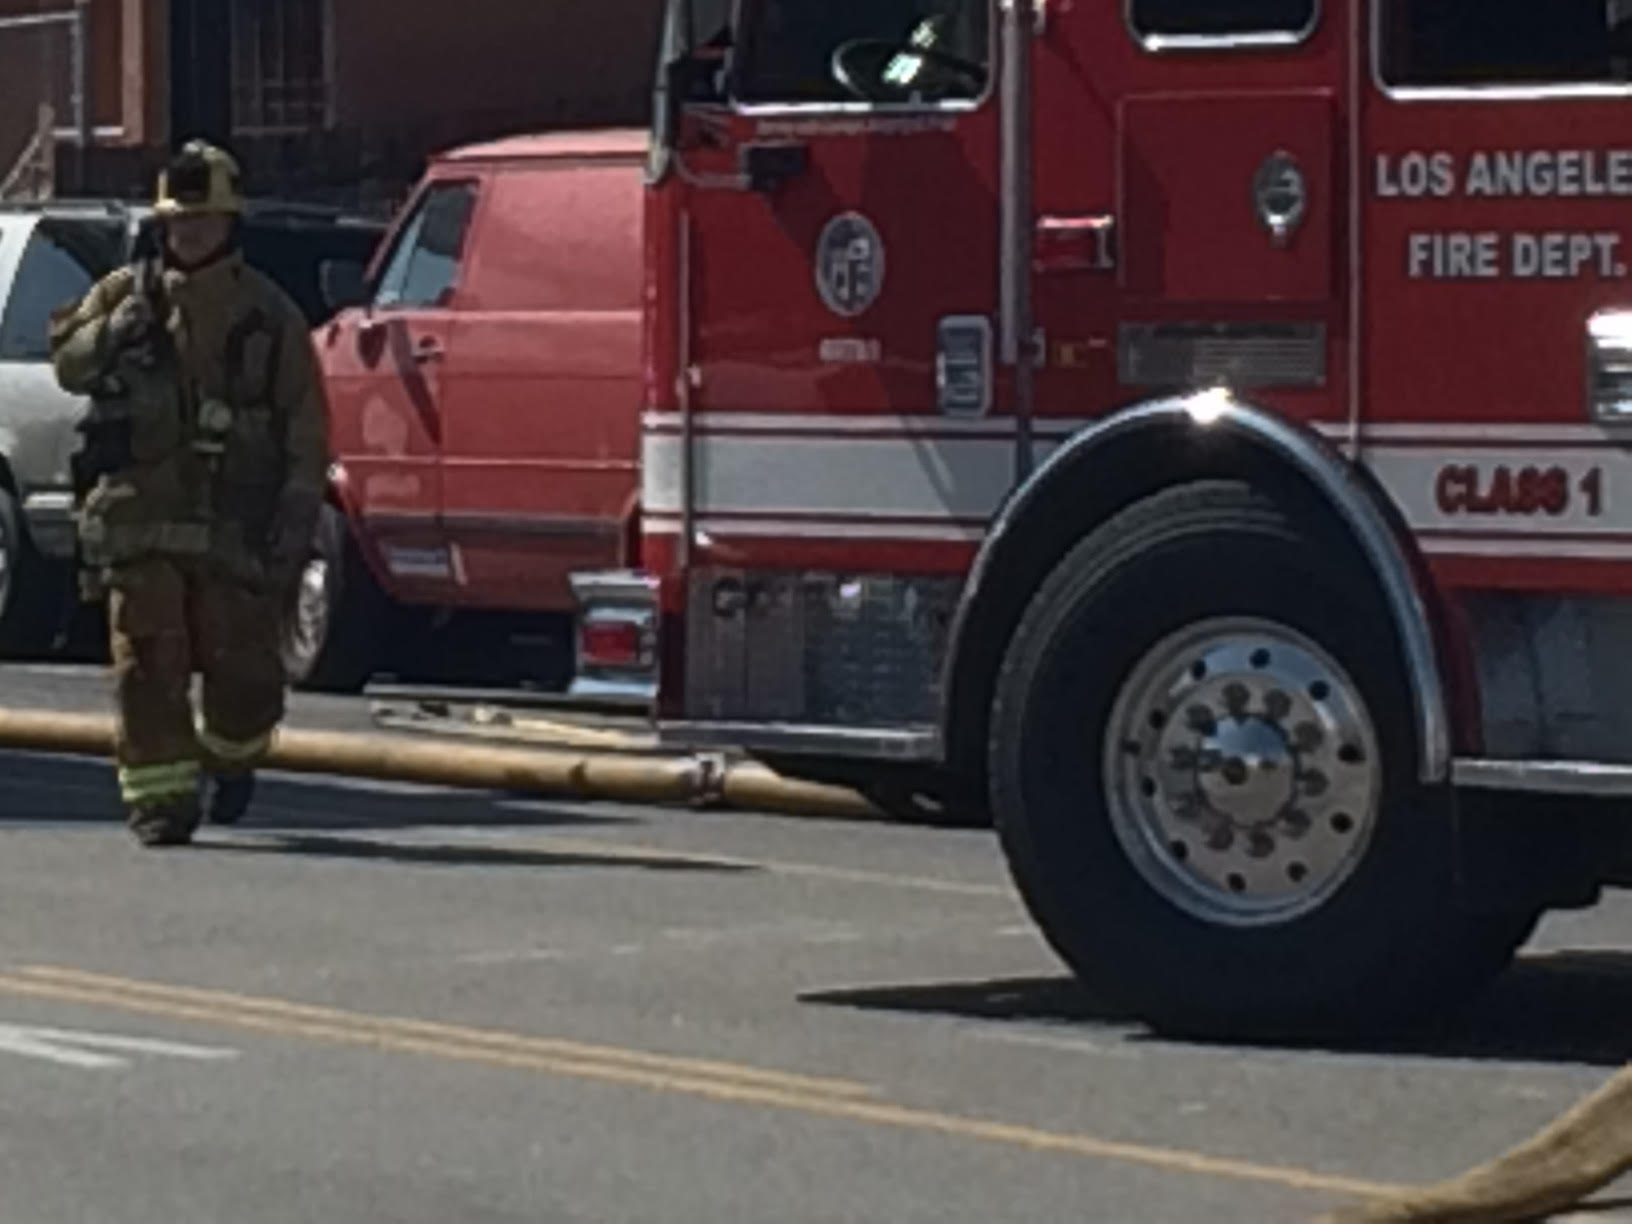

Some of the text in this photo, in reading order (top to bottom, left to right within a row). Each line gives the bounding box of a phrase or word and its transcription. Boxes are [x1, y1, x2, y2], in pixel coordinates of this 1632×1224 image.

[1375, 149, 1632, 197] LOS ANGELE
[1407, 232, 1628, 277] FIRE DEPT.
[1435, 462, 1604, 517] CLASS 1
